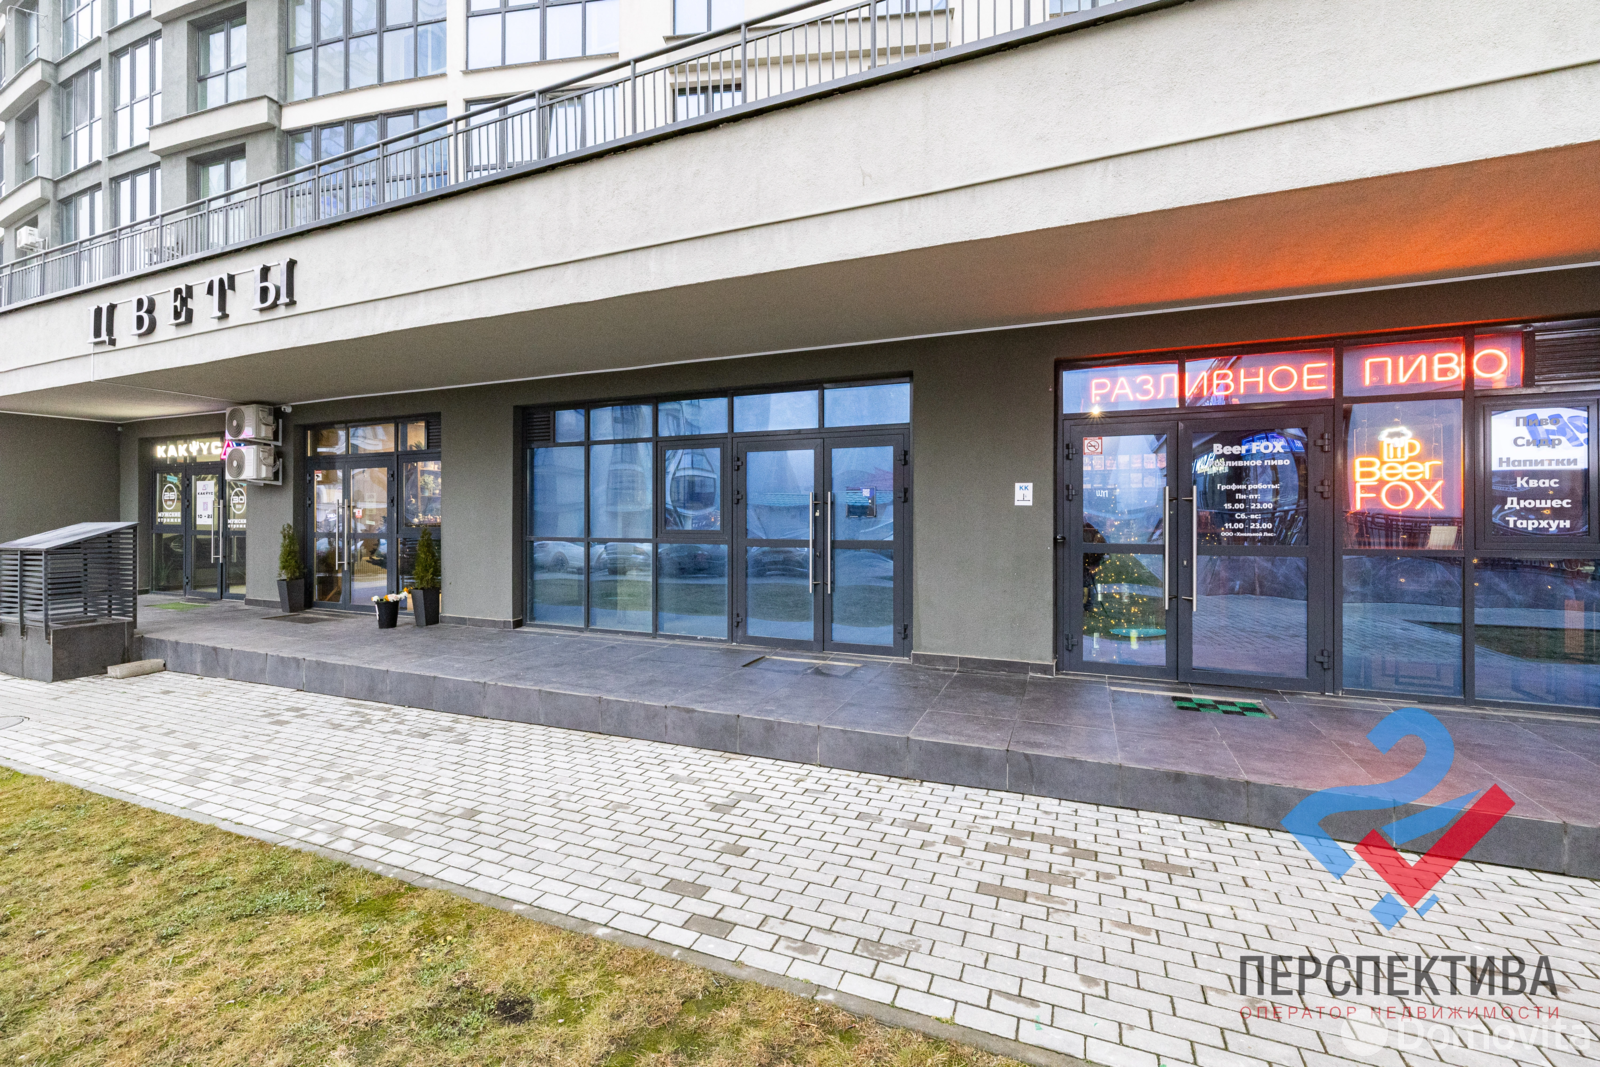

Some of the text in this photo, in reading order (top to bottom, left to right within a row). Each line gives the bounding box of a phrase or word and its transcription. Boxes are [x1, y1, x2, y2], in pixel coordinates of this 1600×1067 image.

[87, 257, 298, 347] ЦВЕТЫ
[1090, 347, 1509, 403] РАЗЛИВНОЕ ПИВО
[1515, 416, 1560, 427] Пиво
[1212, 441, 1285, 455] Beer FOX
[1513, 436, 1562, 448] Сидр
[1264, 458, 1290, 466] пиво
[1498, 457, 1578, 468] Напитки
[1354, 457, 1442, 481] Beer
[1217, 483, 1247, 491] График
[1516, 476, 1560, 488] Квас
[1355, 480, 1444, 510] FOX
[1504, 497, 1572, 509] Дюшес
[1505, 517, 1570, 530] Тархун
